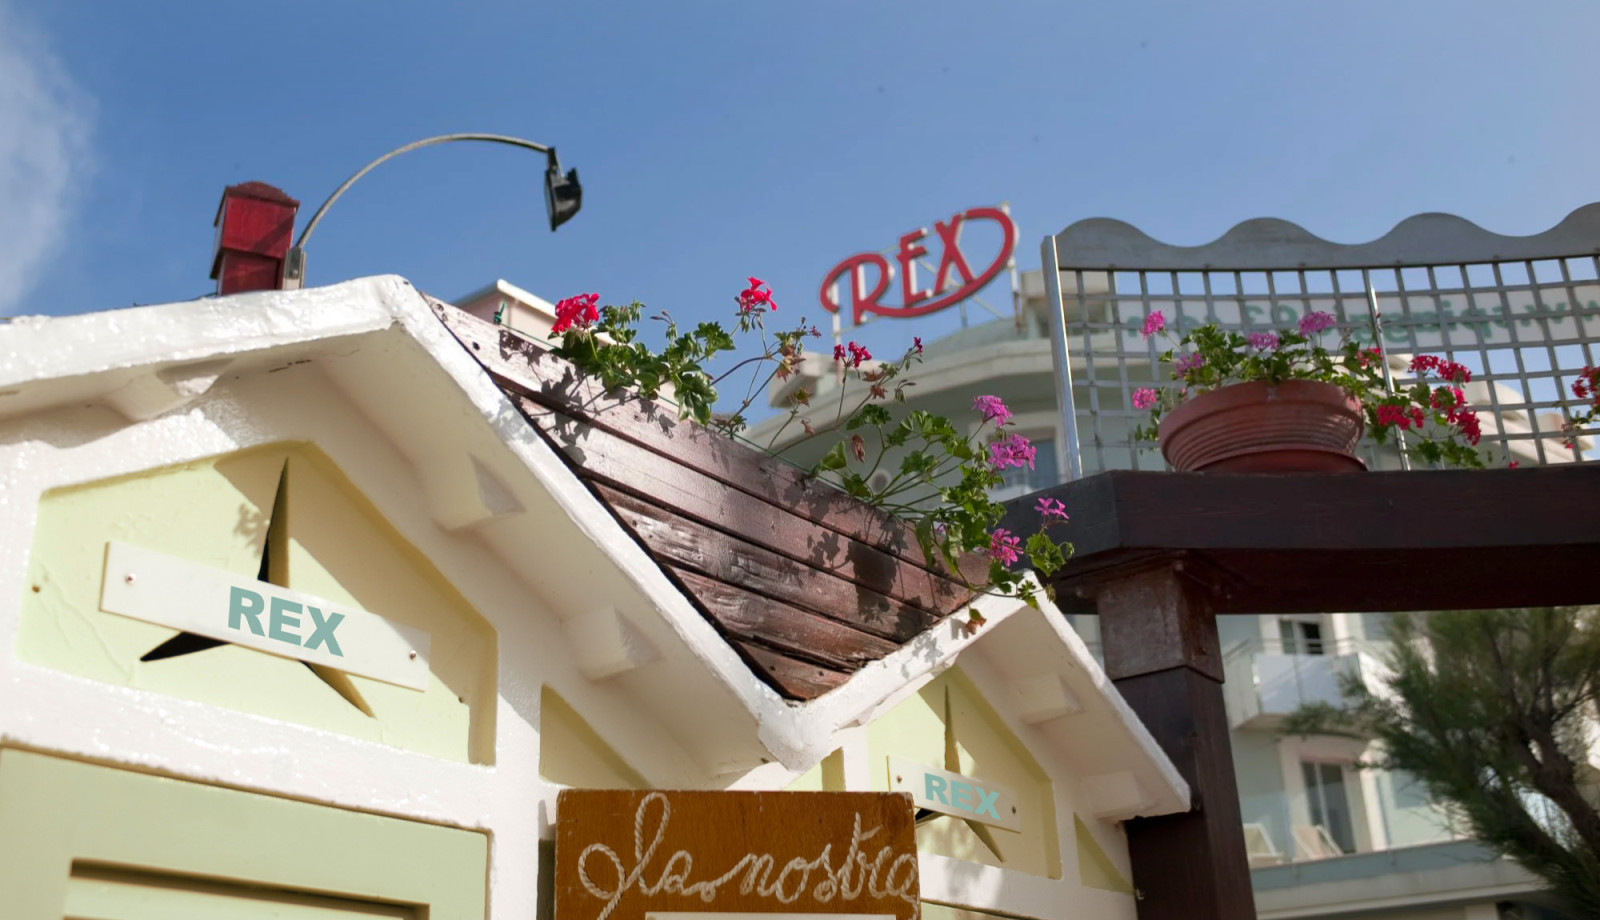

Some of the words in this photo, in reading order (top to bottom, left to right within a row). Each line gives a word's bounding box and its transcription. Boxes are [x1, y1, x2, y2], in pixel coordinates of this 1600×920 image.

[819, 207, 1015, 326] REX
[227, 585, 346, 658] REX
[924, 772, 1002, 821] REX
[738, 811, 919, 904] nostra
